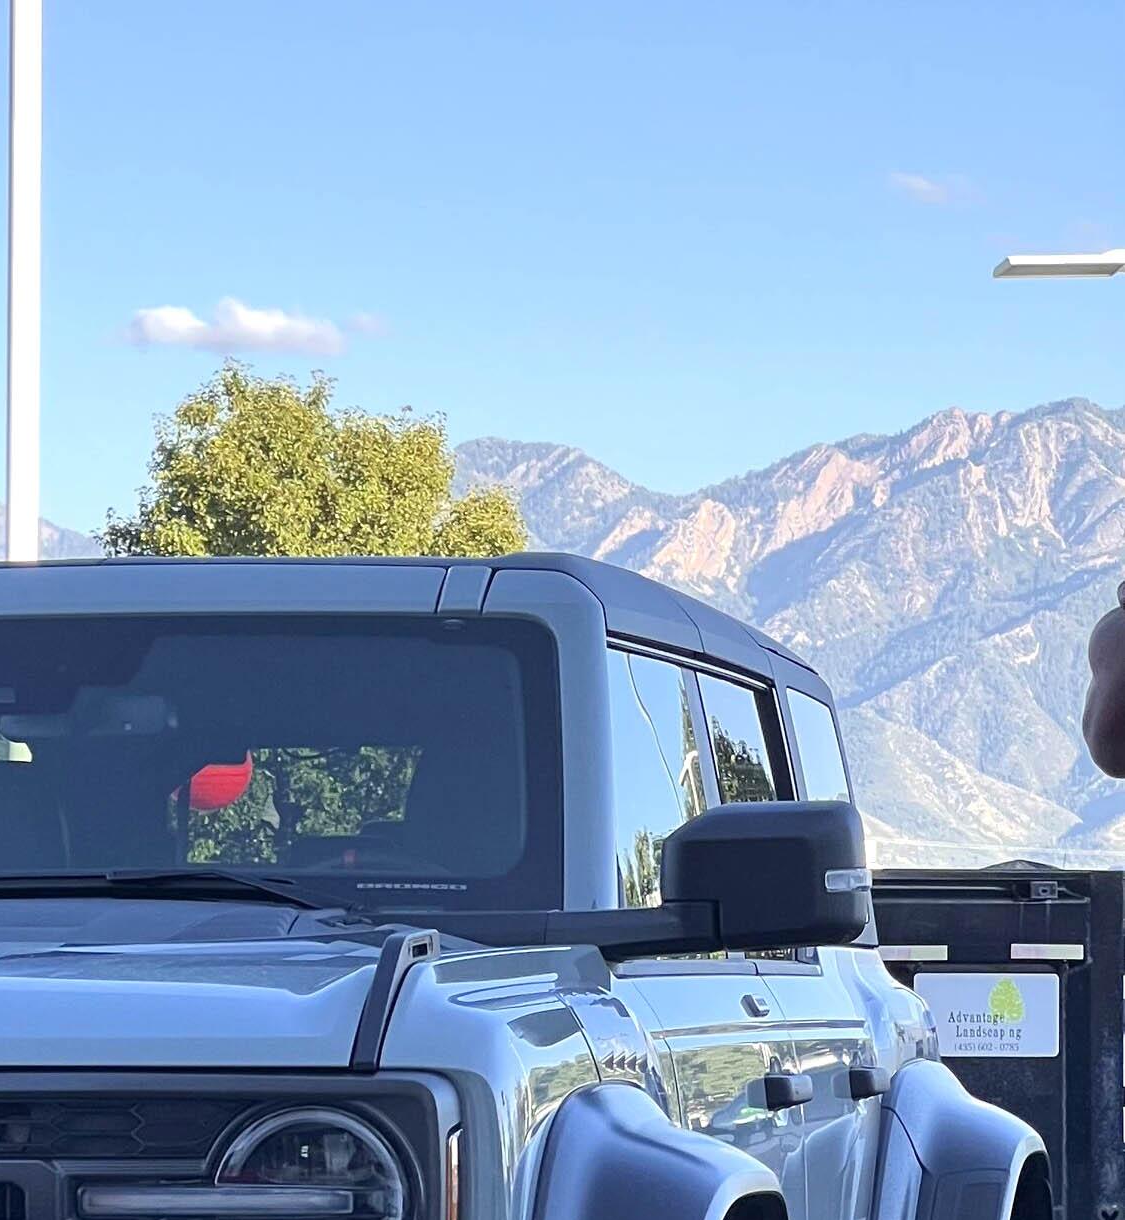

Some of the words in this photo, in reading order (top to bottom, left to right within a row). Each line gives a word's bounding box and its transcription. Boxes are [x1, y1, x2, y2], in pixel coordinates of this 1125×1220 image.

[356, 882, 468, 891] BRONCO
[948, 1011, 1005, 1026] Advantage
[955, 1025, 1022, 1041] Landscapng
